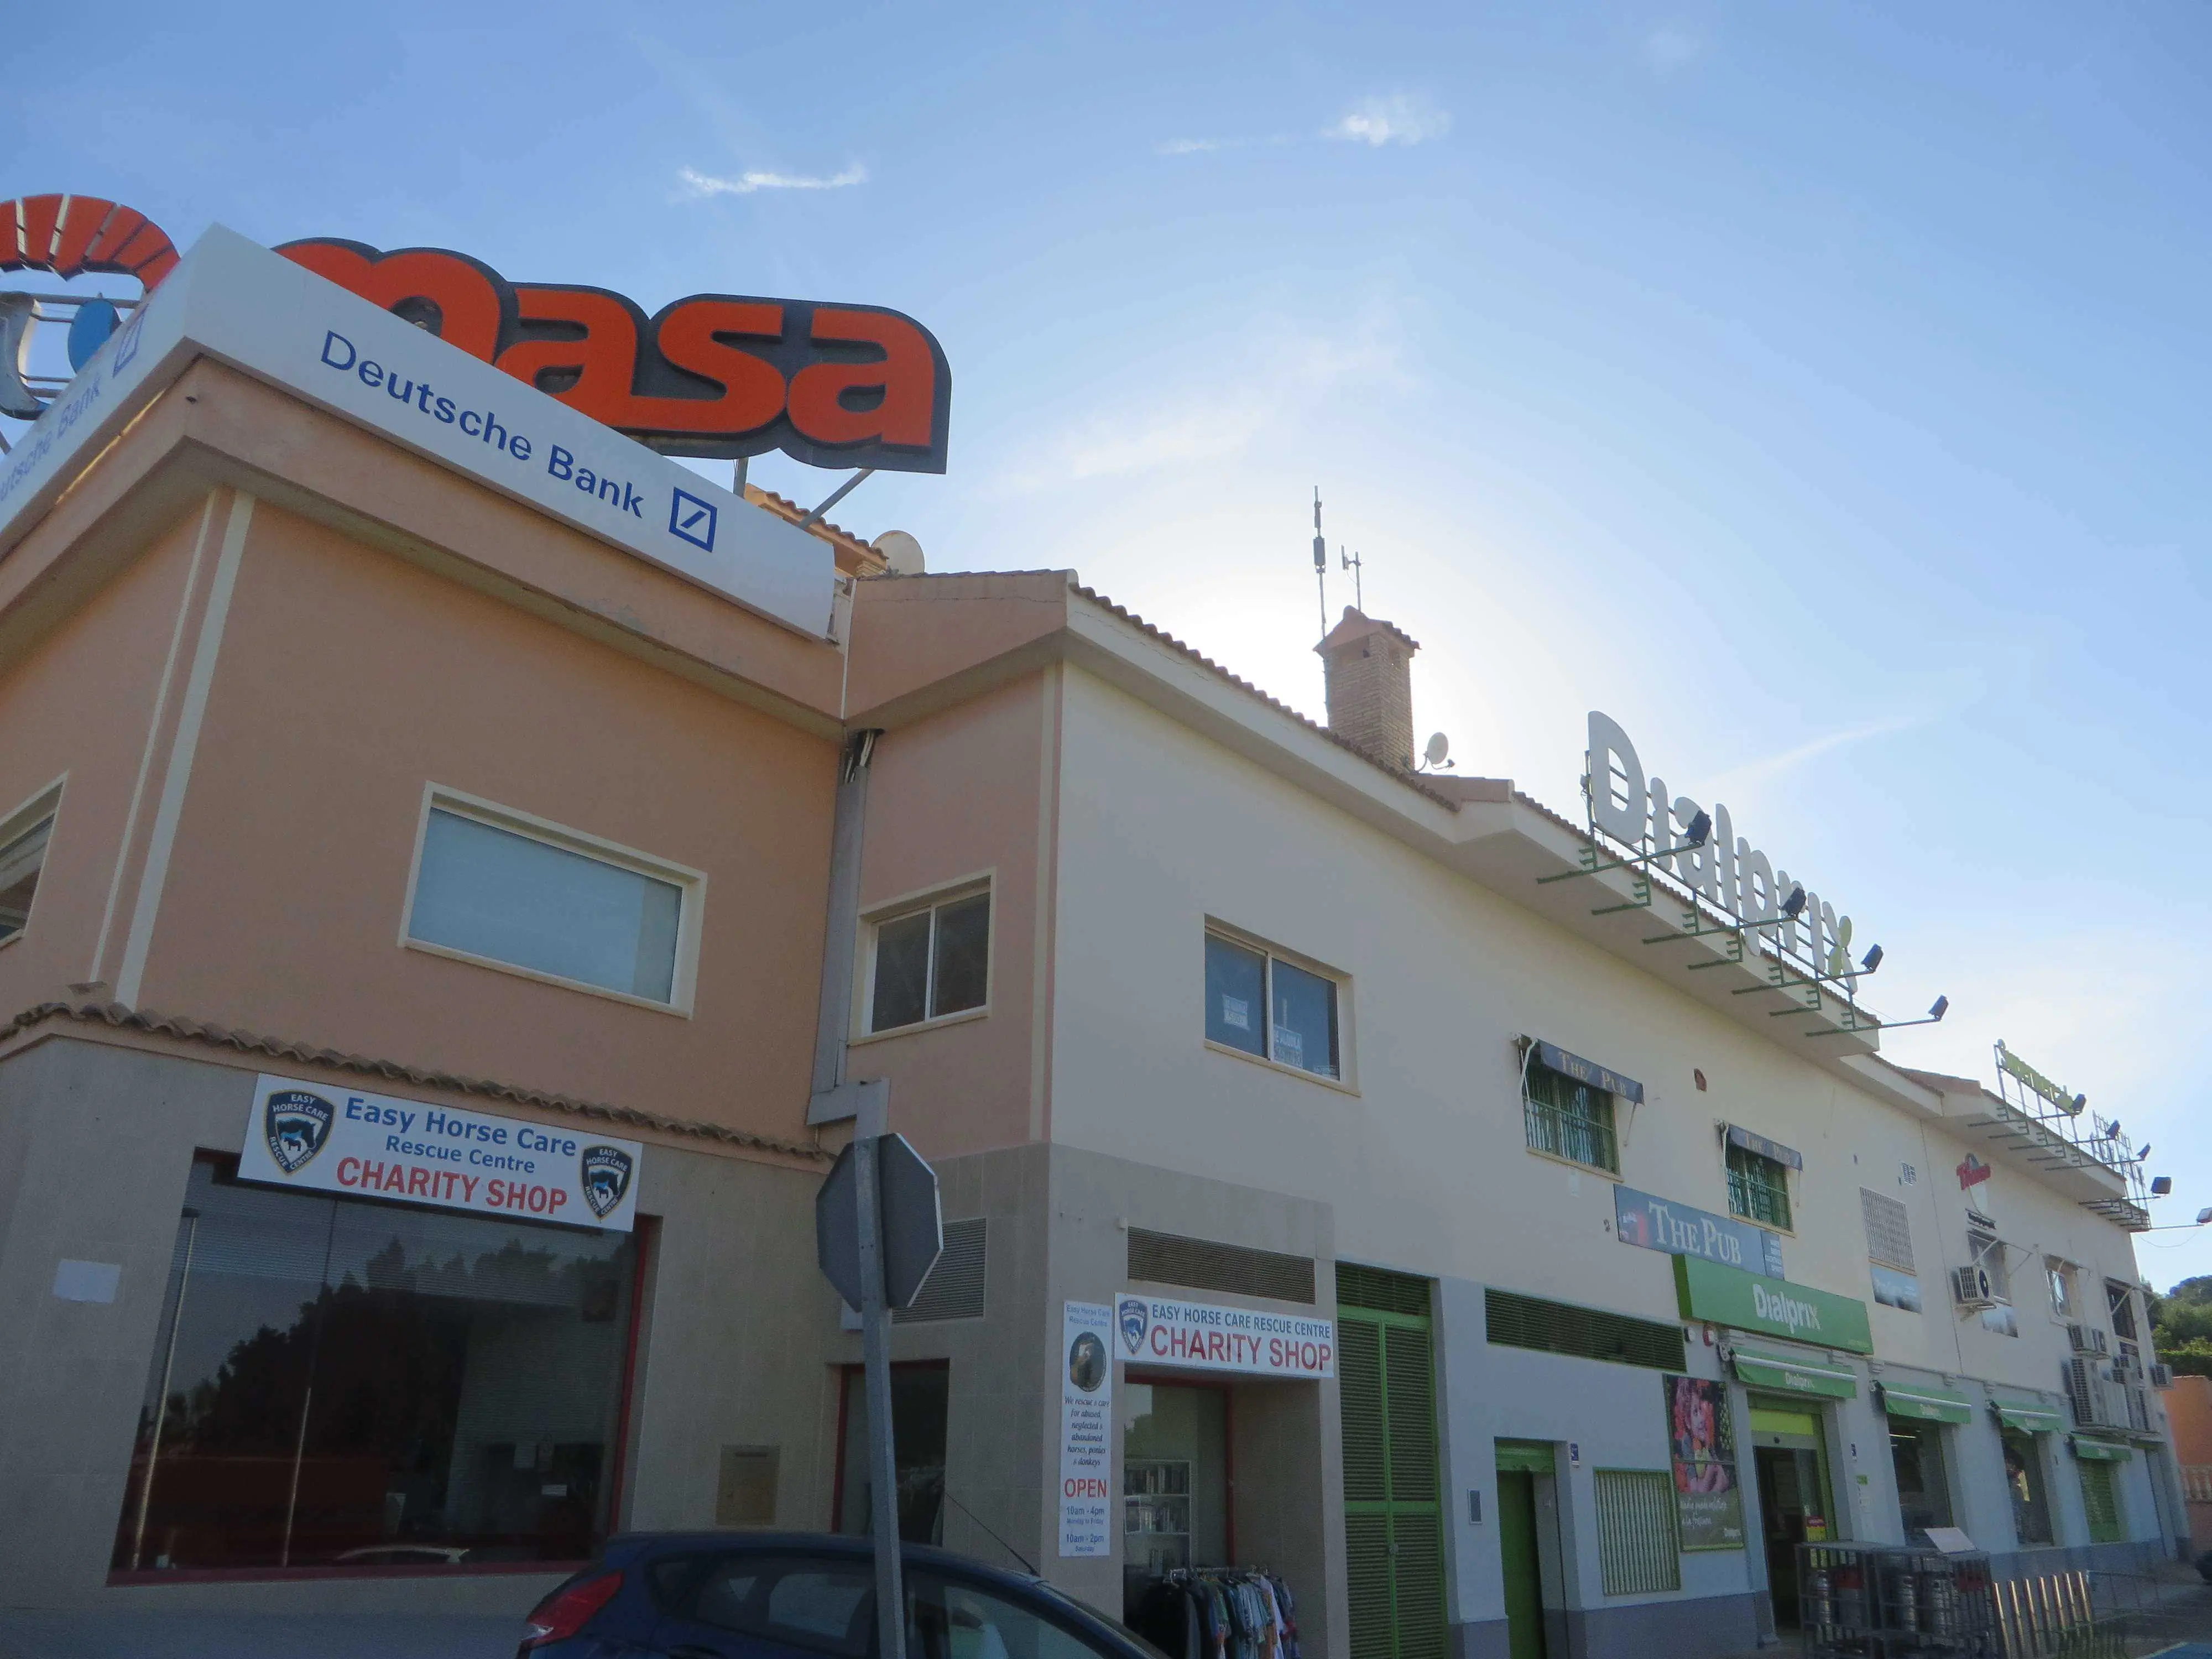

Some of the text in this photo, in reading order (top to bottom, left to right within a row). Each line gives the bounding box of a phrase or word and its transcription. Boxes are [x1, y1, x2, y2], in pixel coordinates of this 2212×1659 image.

[57, 372, 102, 440] Bank
[320, 330, 645, 519] Deutsche Bank
[291, 1093, 316, 1104] EASY
[273, 1104, 330, 1121] HORSE CARE
[346, 1097, 576, 1156] Easy Horse Care
[269, 1136, 289, 1167] RESCUE
[289, 1150, 314, 1170] CENTRE
[385, 1135, 535, 1173] Rescue Centre
[599, 1149, 618, 1157] EASY
[586, 1157, 628, 1172] HORSE CARE
[336, 1156, 568, 1215] CHARITY SHOP
[1066, 1305, 1079, 1314] Easy
[1752, 1283, 1822, 1334] Dialprix
[1152, 1303, 1331, 1339] EASY HORSE CARE RESCUE CENTRE
[1150, 1324, 1262, 1365] CHARITY
[1269, 1337, 1332, 1371] SHOP
[1065, 1396, 1073, 1405] We
[1071, 1408, 1080, 1417] for
[1071, 1421, 1099, 1431] neglected
[1071, 1433, 1103, 1442] abandoned
[1078, 1457, 1100, 1468] donkeys
[1064, 1478, 1107, 1498] OPEN
[1066, 1506, 1085, 1515] 10am
[1090, 1505, 1105, 1516] 4pm
[1066, 1533, 1085, 1543] 10am
[1090, 1533, 1105, 1545] 2pm
